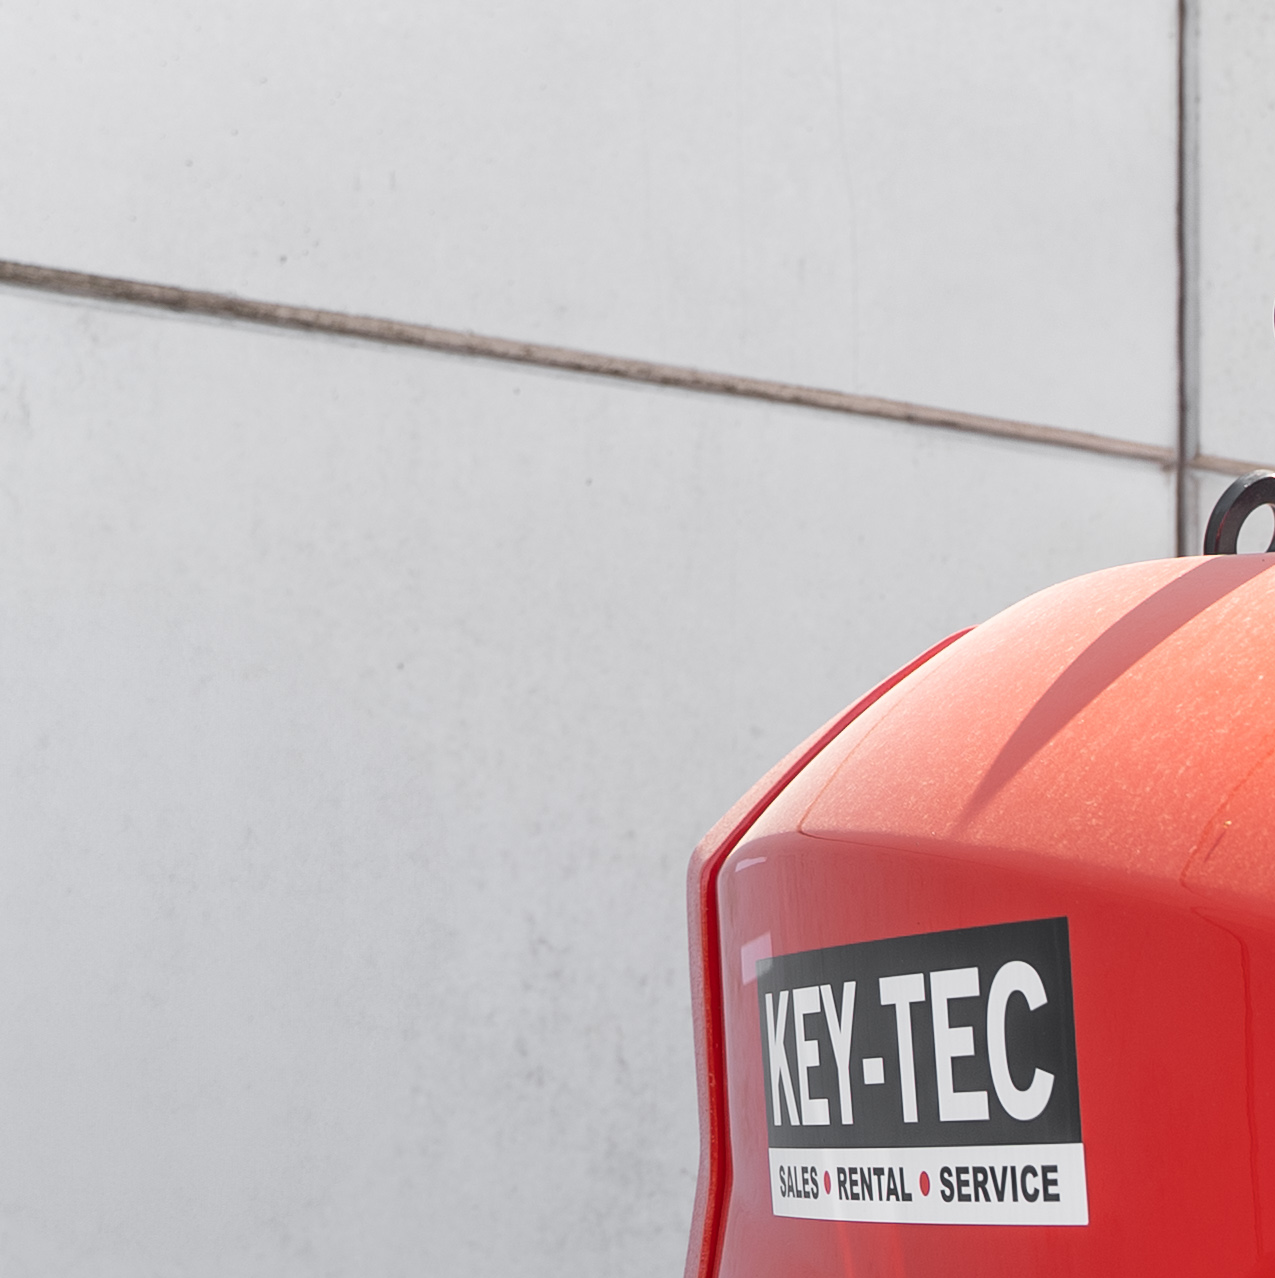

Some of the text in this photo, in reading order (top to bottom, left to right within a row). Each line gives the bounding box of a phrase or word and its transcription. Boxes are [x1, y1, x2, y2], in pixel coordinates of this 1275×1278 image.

[765, 960, 1055, 1127] KEY-TEC
[778, 1164, 1061, 1203] SALES RENTAL SERVICE
